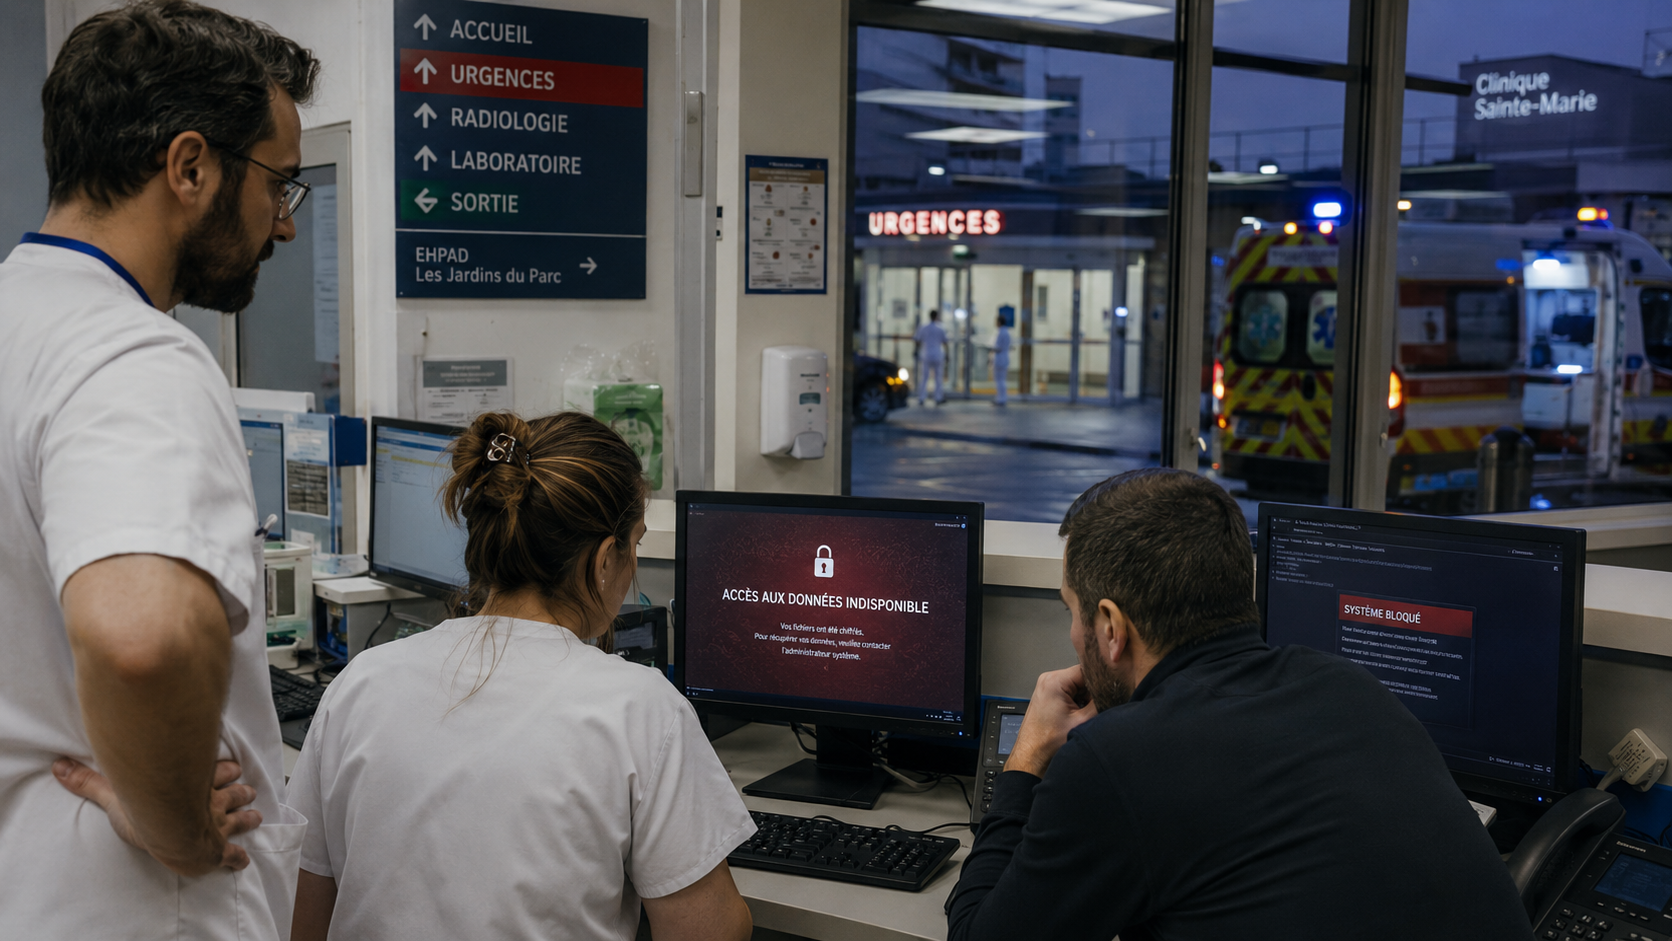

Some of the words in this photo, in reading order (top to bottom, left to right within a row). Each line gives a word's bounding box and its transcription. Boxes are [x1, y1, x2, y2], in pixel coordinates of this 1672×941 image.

[450, 19, 533, 45] ACCUEIL
[451, 64, 555, 90] URGENCES
[1475, 70, 1550, 97] Clinique
[1474, 89, 1598, 120] Sainte-Marie
[451, 108, 568, 133] RADIOLOGIE
[451, 150, 582, 175] LABORATOIRE
[451, 192, 519, 213] SORTIE
[868, 209, 1002, 236] URGENCES
[415, 247, 469, 263] EHPAD
[415, 266, 442, 283] Les
[446, 267, 501, 283] Jardins
[506, 268, 525, 283] du
[529, 268, 562, 284] Parc
[722, 586, 759, 603] ACCÈS
[761, 591, 785, 604] AUX
[788, 592, 843, 608] DONNÉES
[846, 597, 929, 614] INDISPONIBLE
[780, 622, 792, 631] Vos
[1344, 604, 1384, 619] SYSTÈME
[1385, 611, 1421, 624] BLOQUÉ
